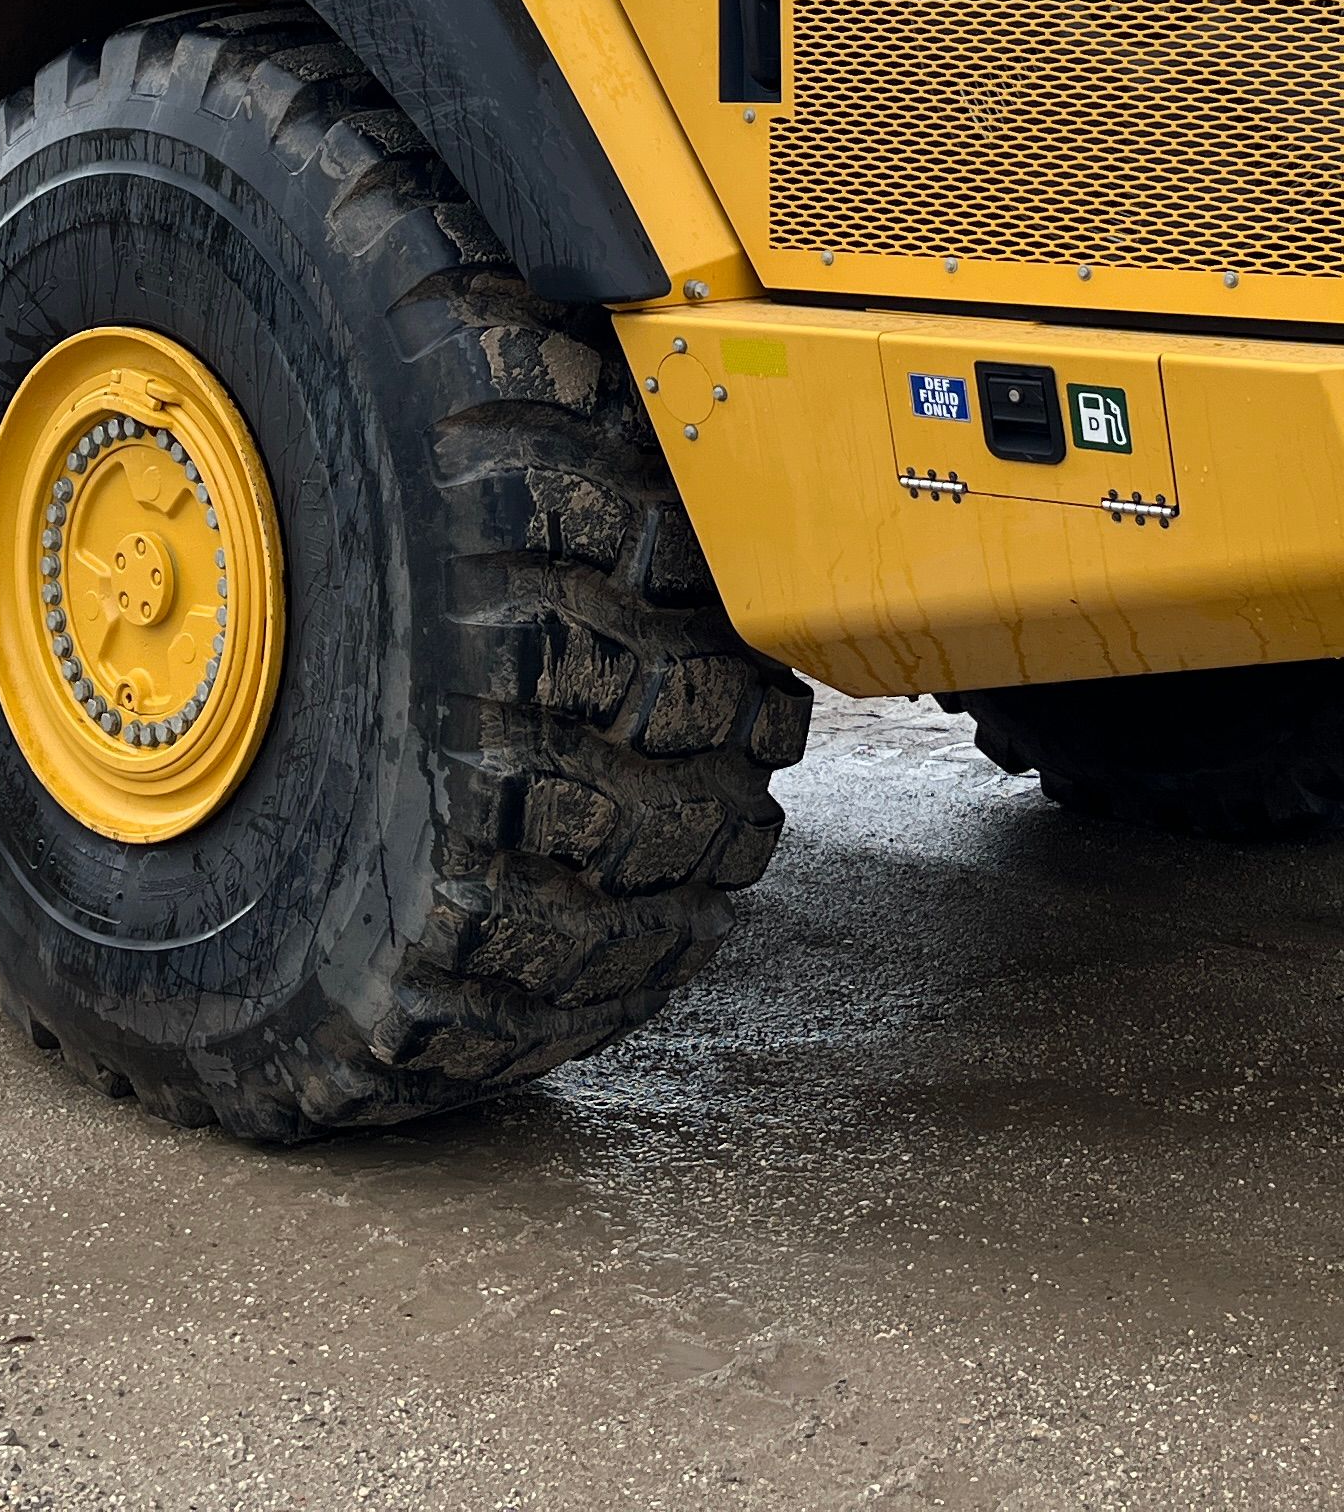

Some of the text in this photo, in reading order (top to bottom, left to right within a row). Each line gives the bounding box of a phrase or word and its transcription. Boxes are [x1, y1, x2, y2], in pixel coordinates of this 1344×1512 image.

[924, 377, 950, 391] DEF
[919, 388, 959, 405] FLUID
[923, 402, 958, 419] ONLY
[1087, 416, 1100, 431] D
